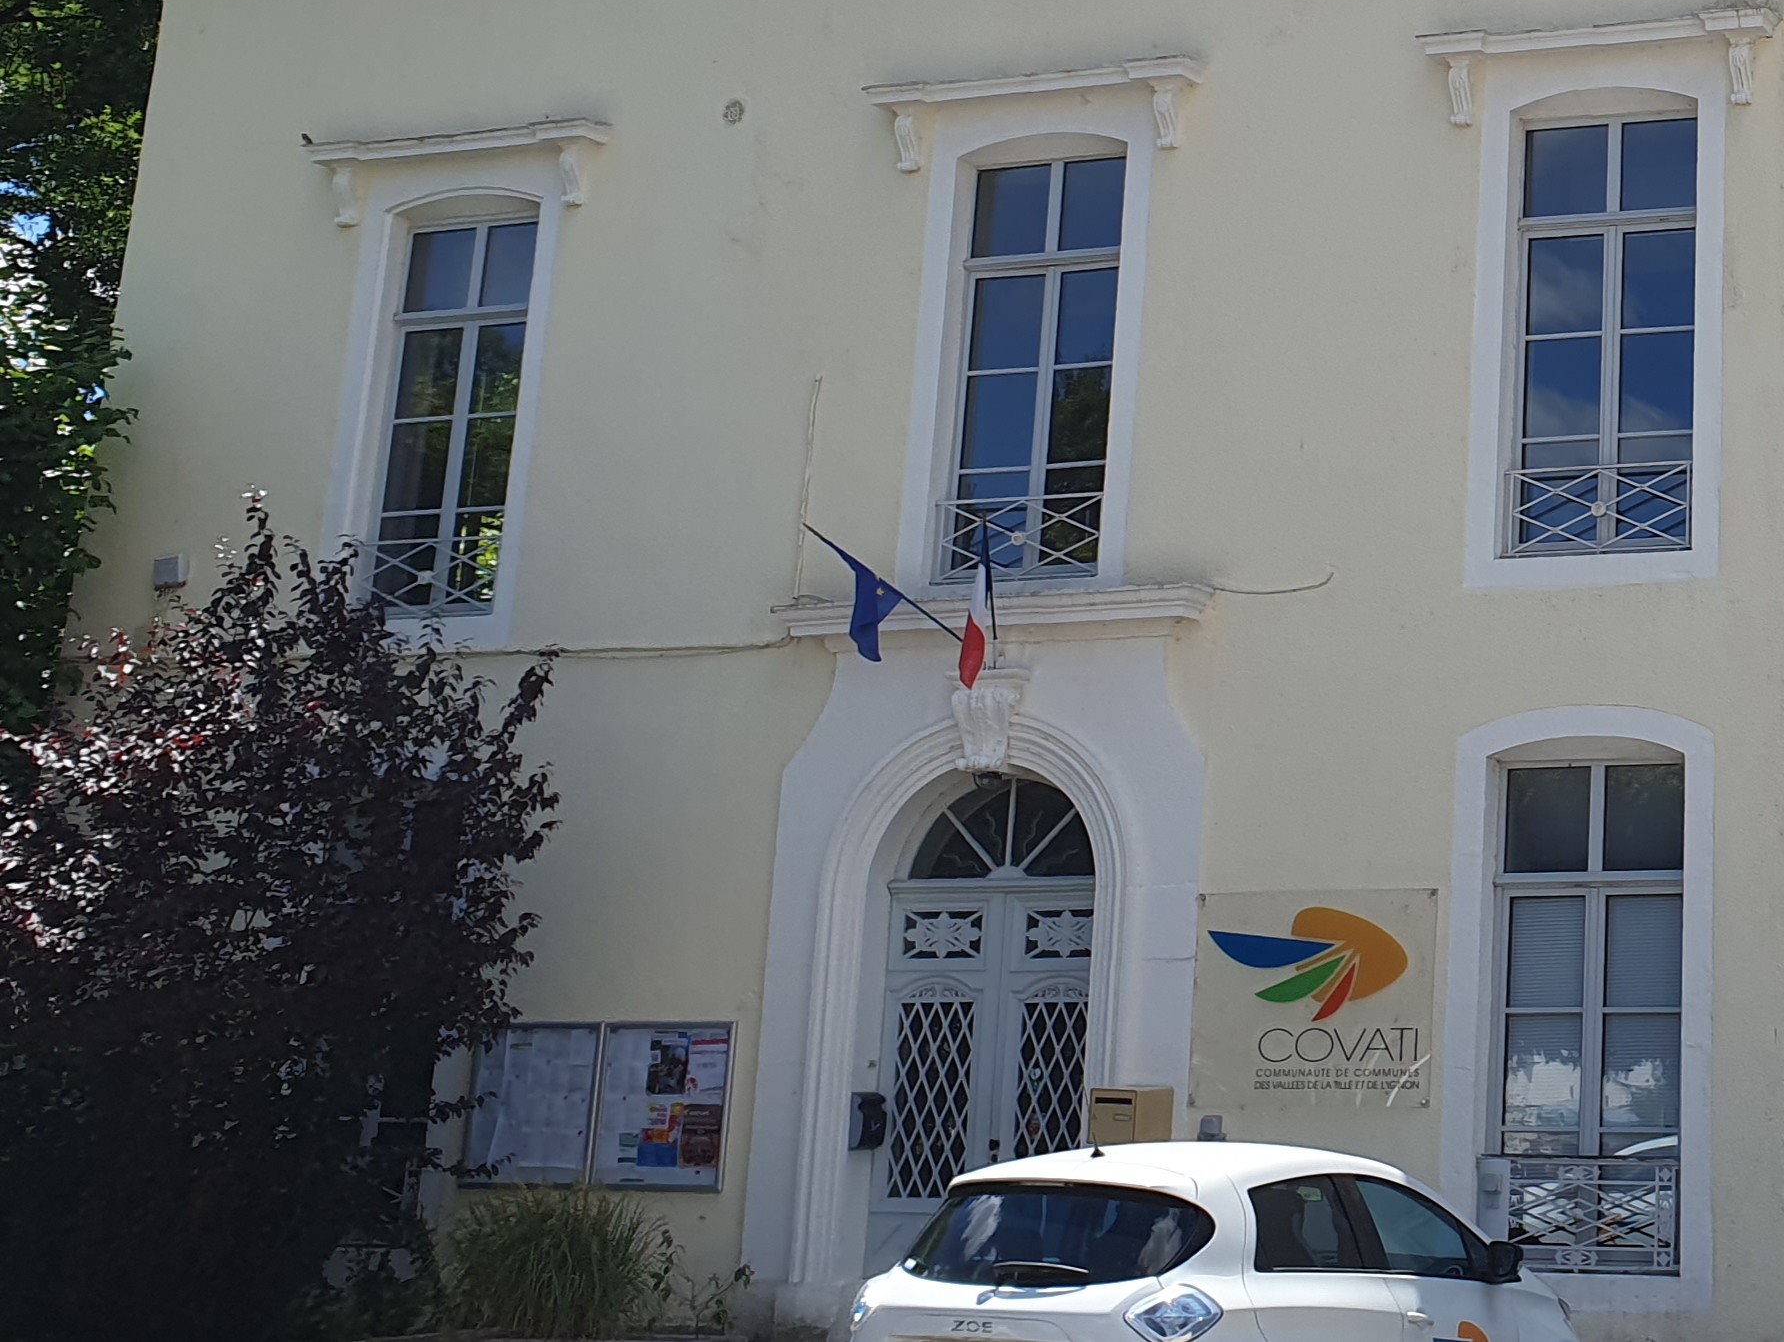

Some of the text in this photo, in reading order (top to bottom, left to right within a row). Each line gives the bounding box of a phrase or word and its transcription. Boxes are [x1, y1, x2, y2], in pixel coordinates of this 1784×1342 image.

[1258, 1027, 1418, 1063] COVATI
[1335, 1068, 1349, 1078] DE
[1353, 1067, 1420, 1078] COMMUNES
[1254, 1080, 1271, 1090] DES
[1307, 1080, 1320, 1090] DE
[1320, 1080, 1333, 1090] LA
[1355, 1080, 1365, 1090] ET
[1366, 1080, 1379, 1090] DE
[951, 1320, 993, 1333] ZOE
